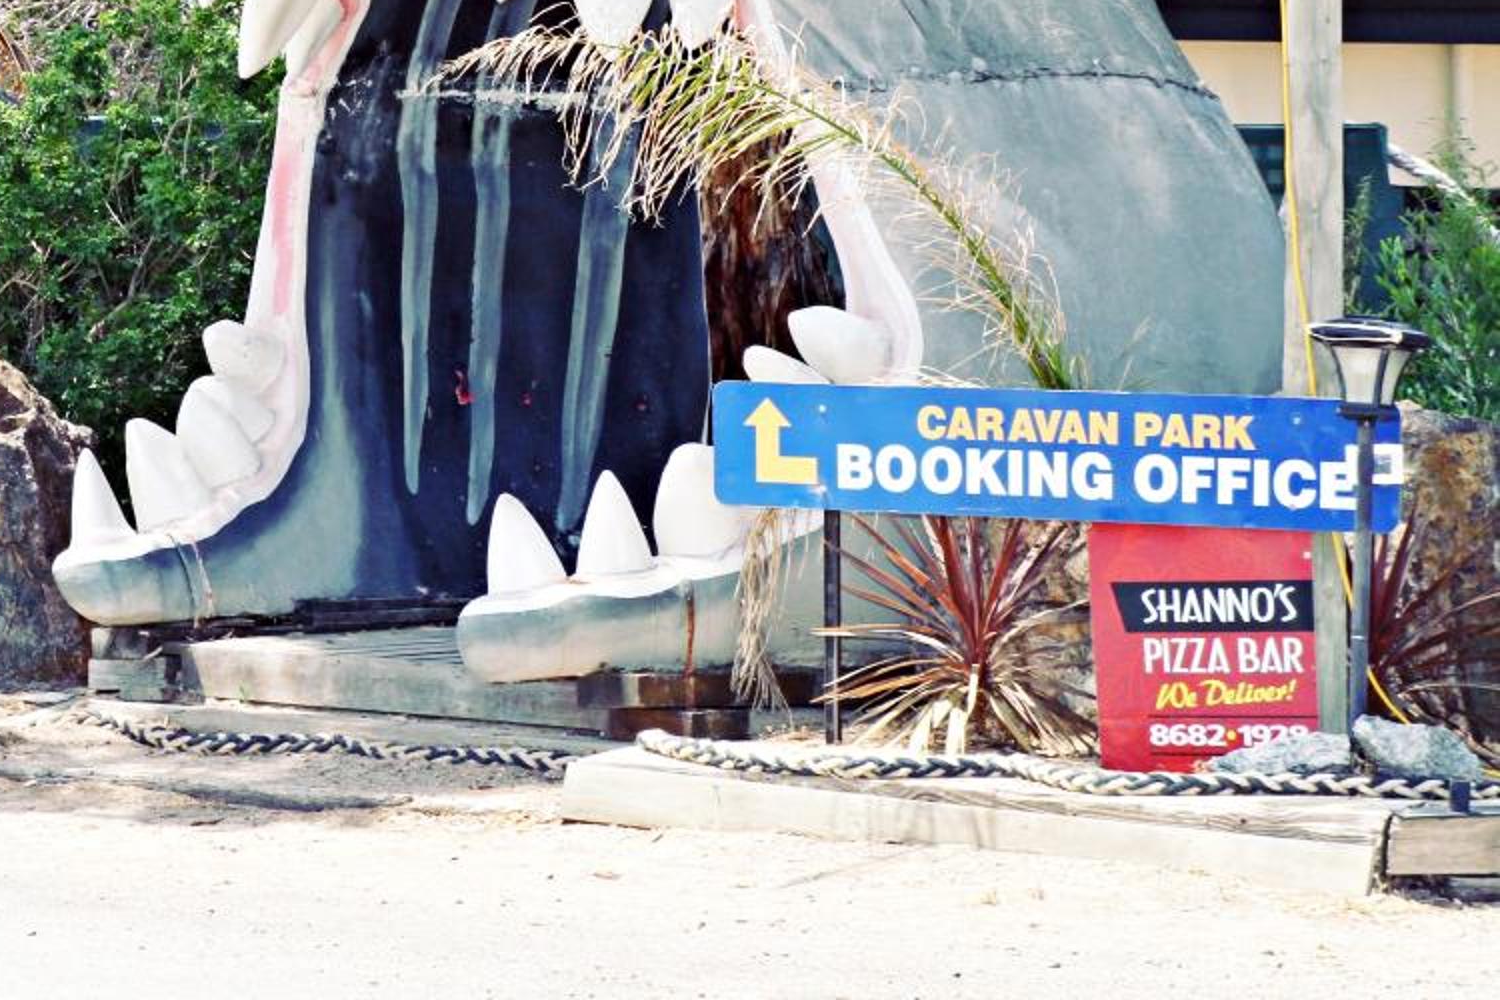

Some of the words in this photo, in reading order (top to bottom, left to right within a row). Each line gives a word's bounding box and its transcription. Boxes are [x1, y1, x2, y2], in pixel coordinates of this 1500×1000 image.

[916, 403, 1118, 446] CARAVAN
[1135, 412, 1257, 451] PARK
[835, 443, 1114, 502] BOOKING
[1133, 453, 1360, 512] OFFICE
[1140, 583, 1298, 624] SHANNO'S
[1142, 637, 1231, 674] PIZZA
[1236, 637, 1305, 674] BAR
[1154, 681, 1197, 711] We
[1199, 678, 1298, 707] Deliver!
